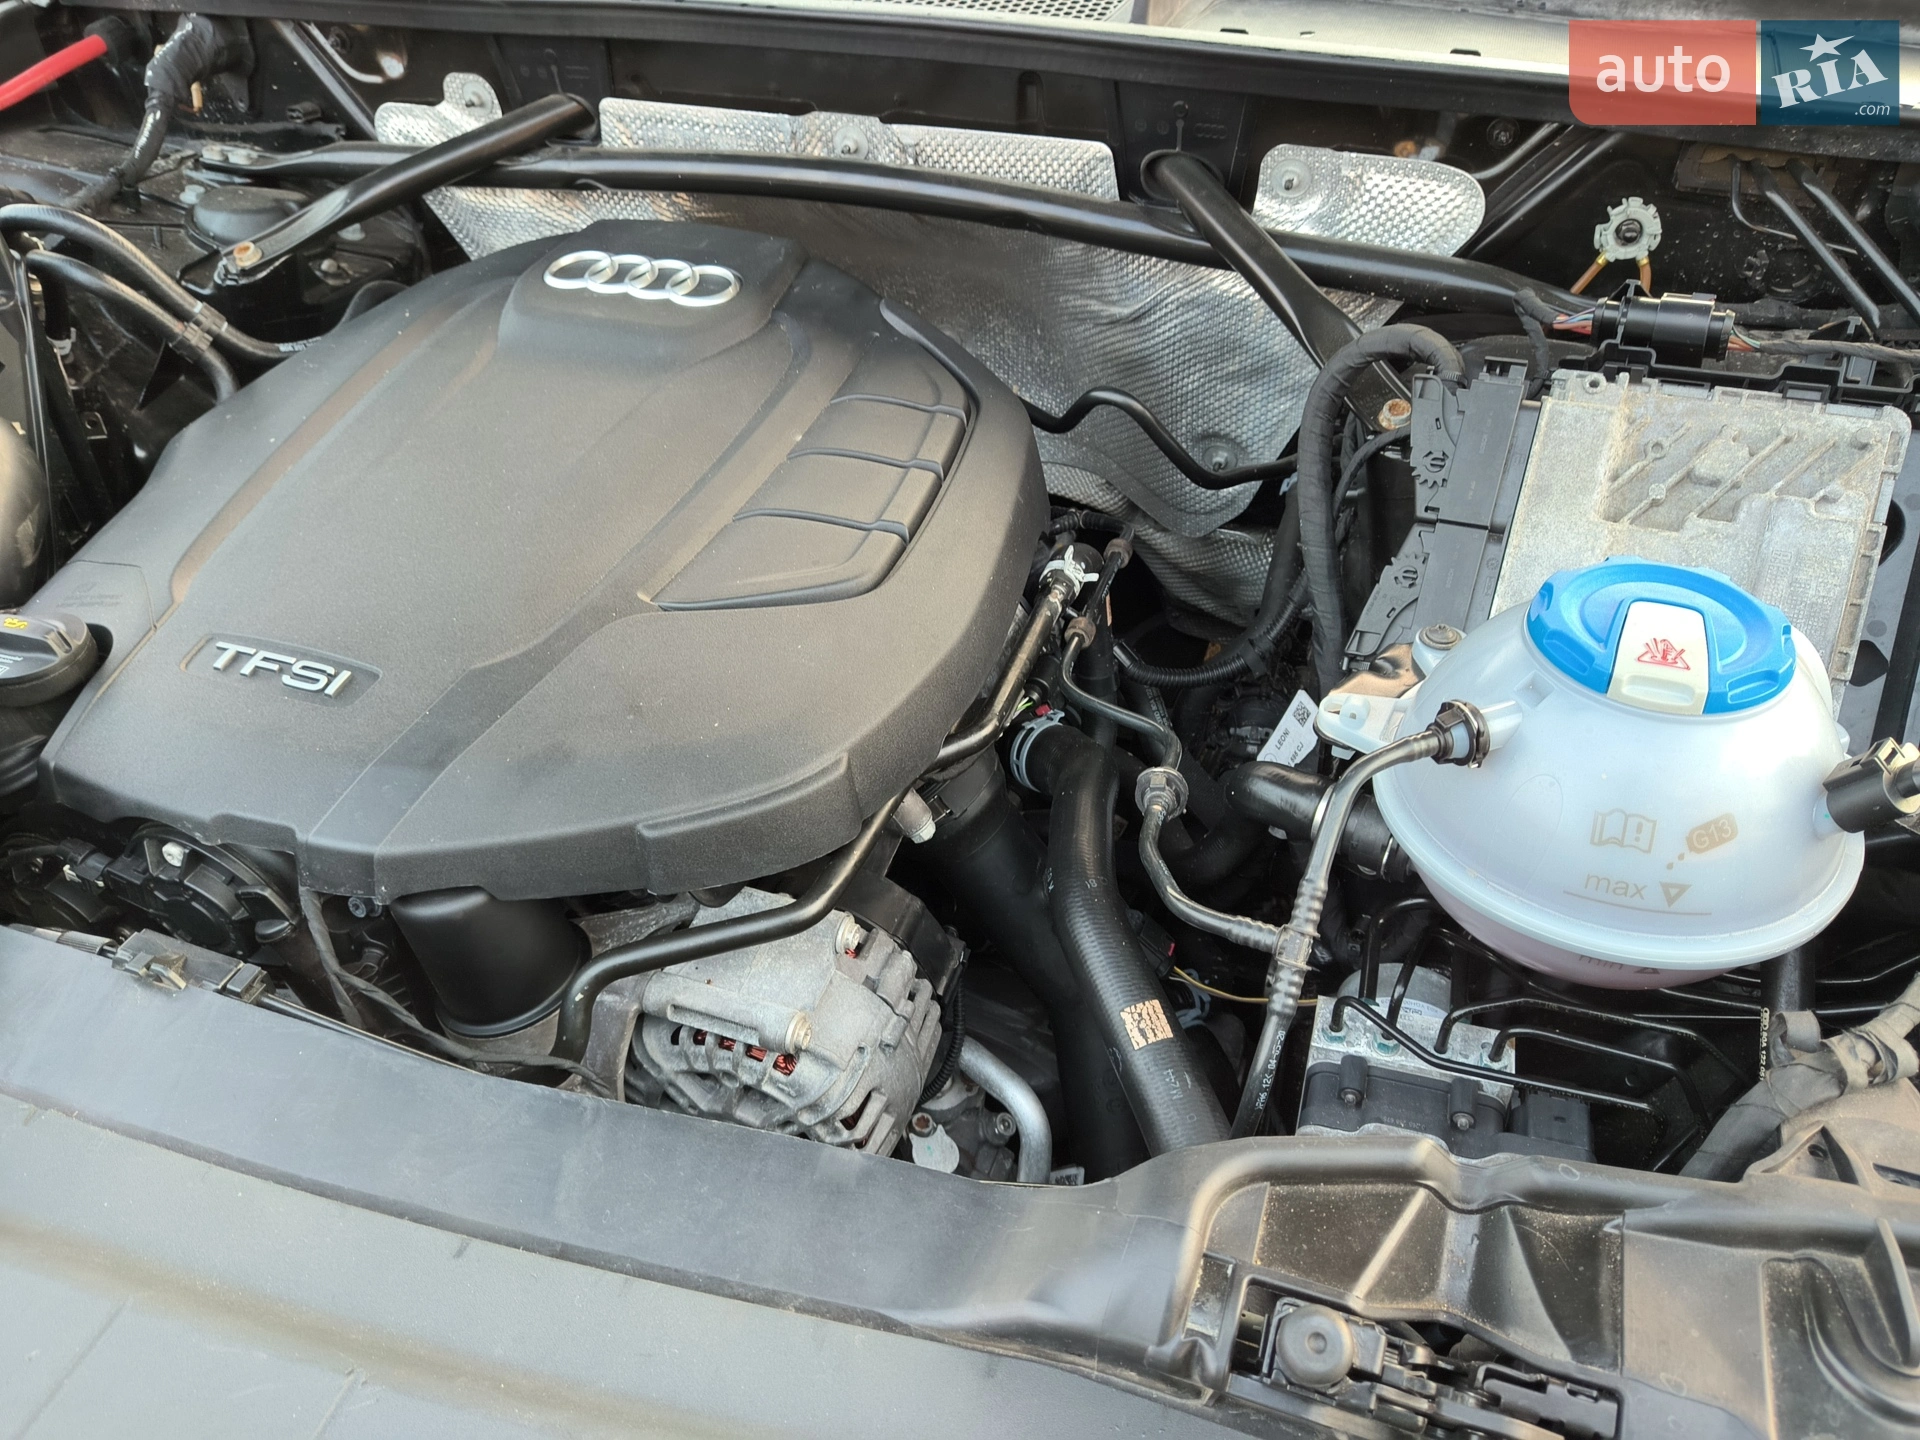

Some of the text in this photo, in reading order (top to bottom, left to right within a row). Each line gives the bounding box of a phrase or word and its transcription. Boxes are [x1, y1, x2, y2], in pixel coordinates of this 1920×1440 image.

[213, 641, 352, 698] TFSI
[1275, 728, 1290, 750] LEONI
[1692, 819, 1732, 849] G13
[1585, 874, 1648, 900] max
